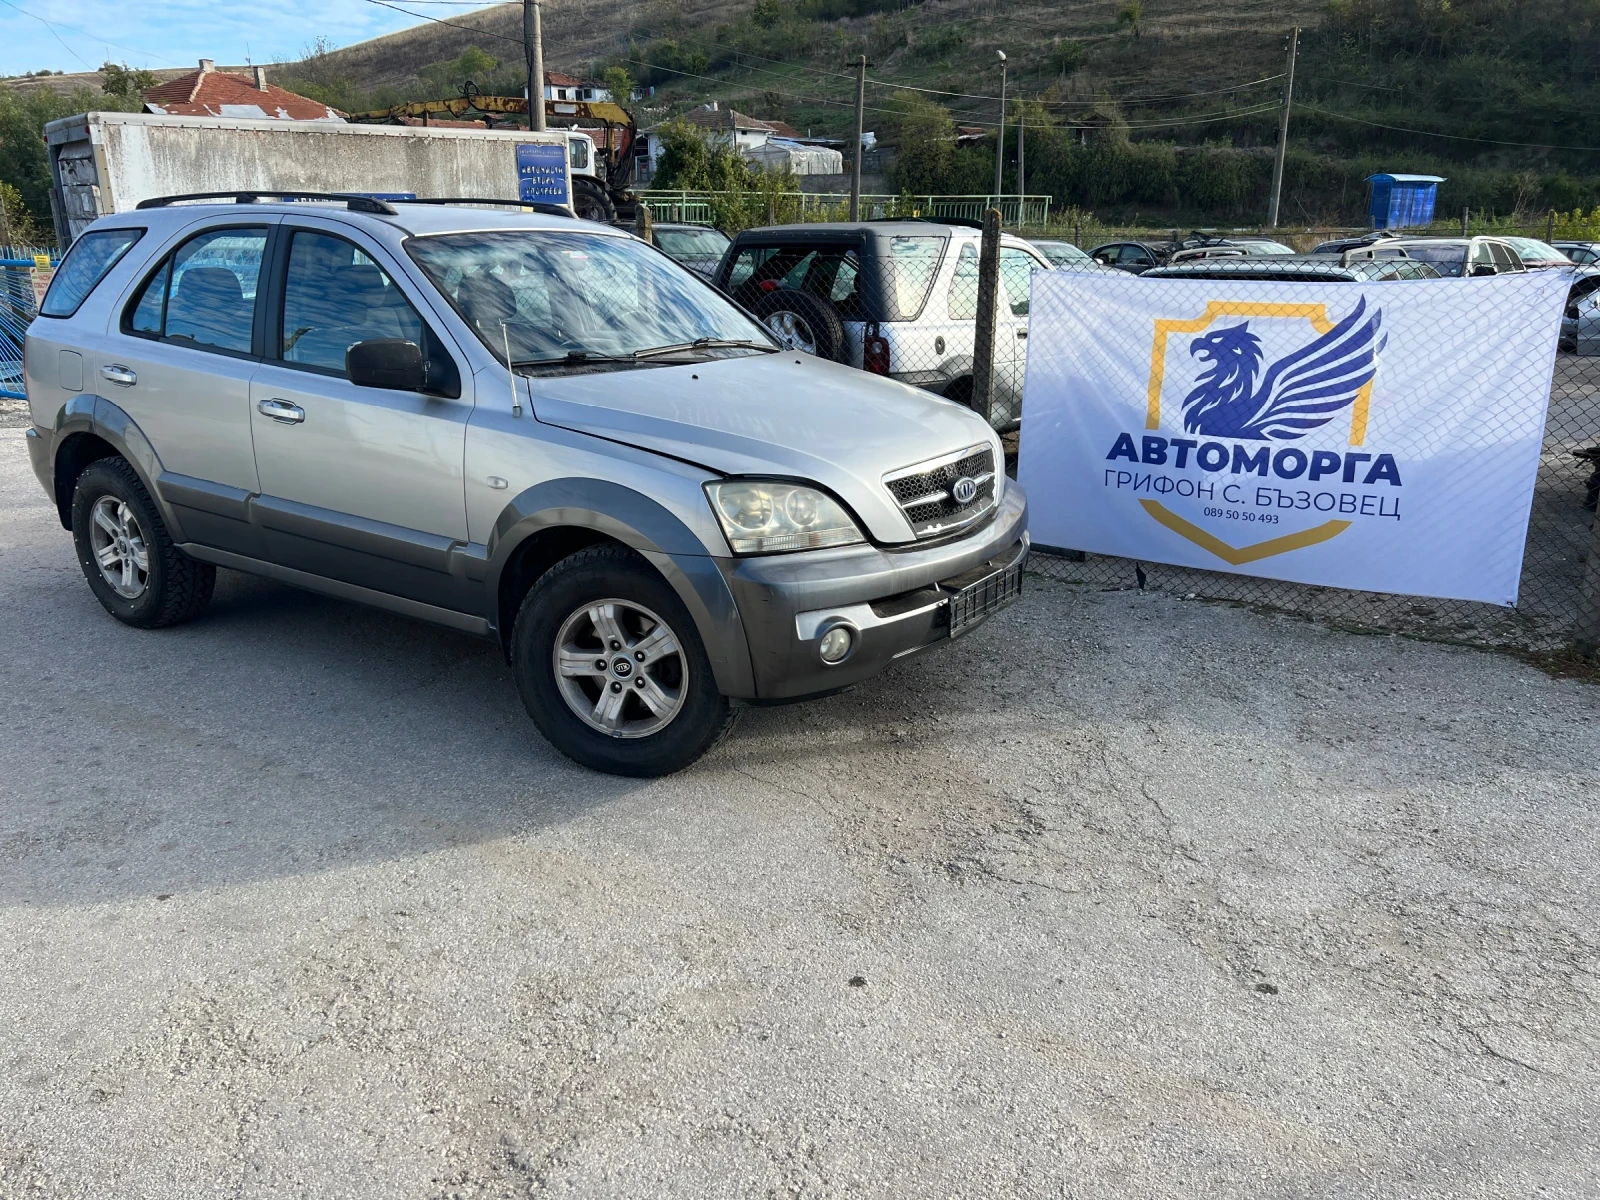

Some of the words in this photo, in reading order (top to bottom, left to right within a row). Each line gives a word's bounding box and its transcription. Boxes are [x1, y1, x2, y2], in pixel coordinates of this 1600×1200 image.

[1105, 432, 1402, 487] АВТОМОРГА
[1104, 469, 1214, 500] ГРИФОН
[1223, 484, 1246, 504] С.
[1255, 487, 1401, 521] БЪЗОВЕЦ
[1203, 502, 1223, 518] 089
[1225, 509, 1239, 520] 50
[1241, 511, 1256, 522] 50
[1258, 513, 1279, 525] 493
